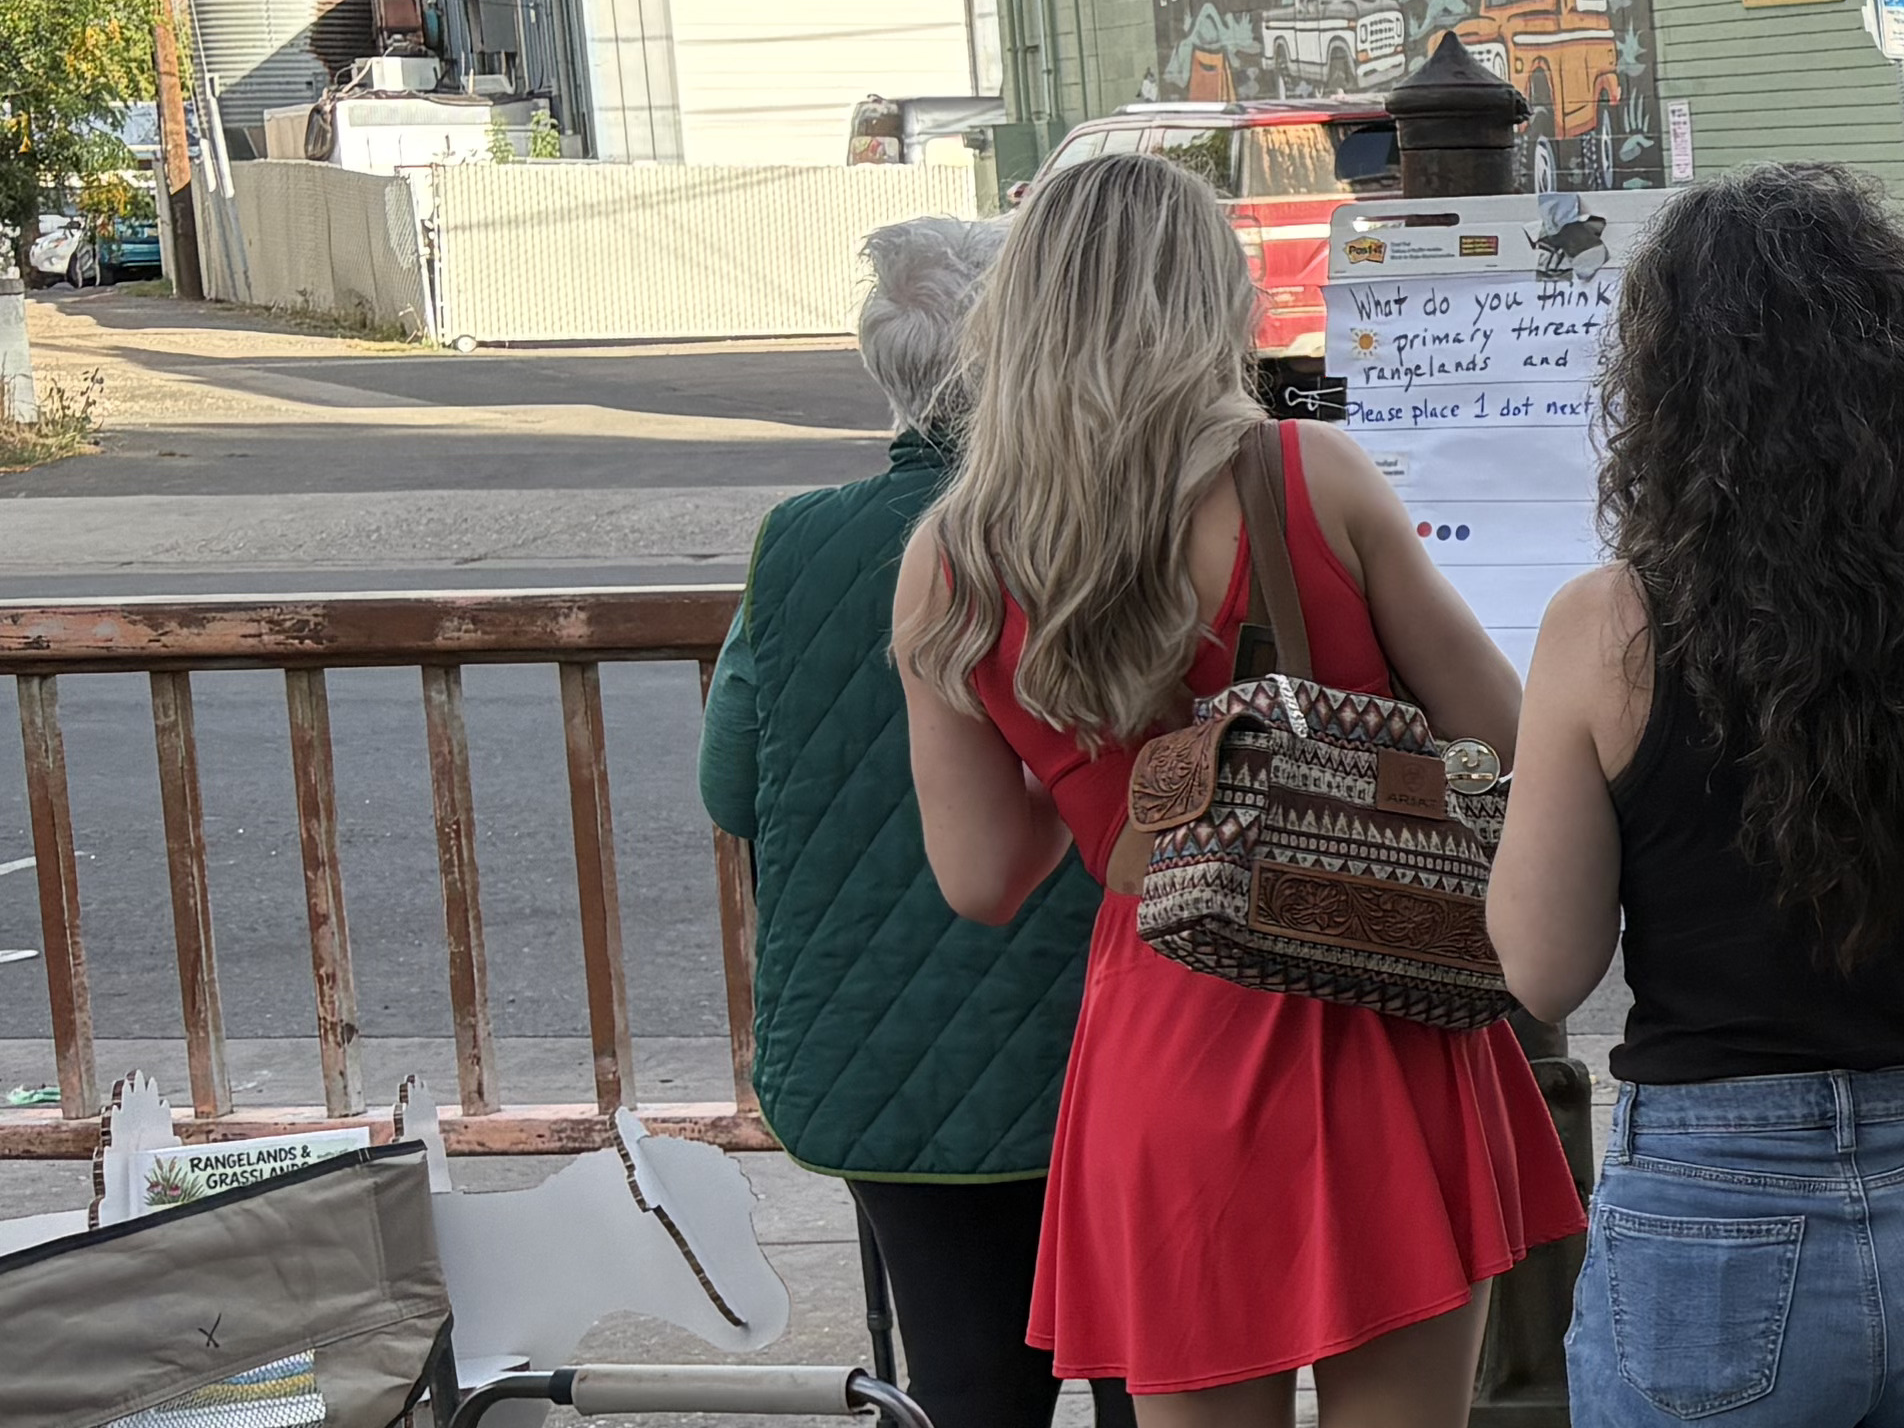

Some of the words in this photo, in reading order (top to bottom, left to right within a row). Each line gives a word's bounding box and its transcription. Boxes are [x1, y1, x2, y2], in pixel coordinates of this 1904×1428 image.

[1348, 242, 1385, 257] Post-it
[1350, 285, 1408, 322] What
[1423, 288, 1450, 317] do
[1474, 290, 1523, 326] you
[1537, 280, 1613, 311] think
[1392, 327, 1494, 367] primary
[1511, 313, 1601, 340] threat
[1363, 354, 1491, 393] rangelands
[1523, 348, 1569, 368] and
[1345, 400, 1403, 426] Please
[1411, 397, 1460, 426] place
[1473, 391, 1490, 419] 1
[1500, 395, 1534, 418] dot
[1546, 394, 1595, 417] next
[189, 1146, 297, 1174] RANGELANDS
[300, 1144, 312, 1160] &
[206, 1161, 310, 1190] GRASSLA
